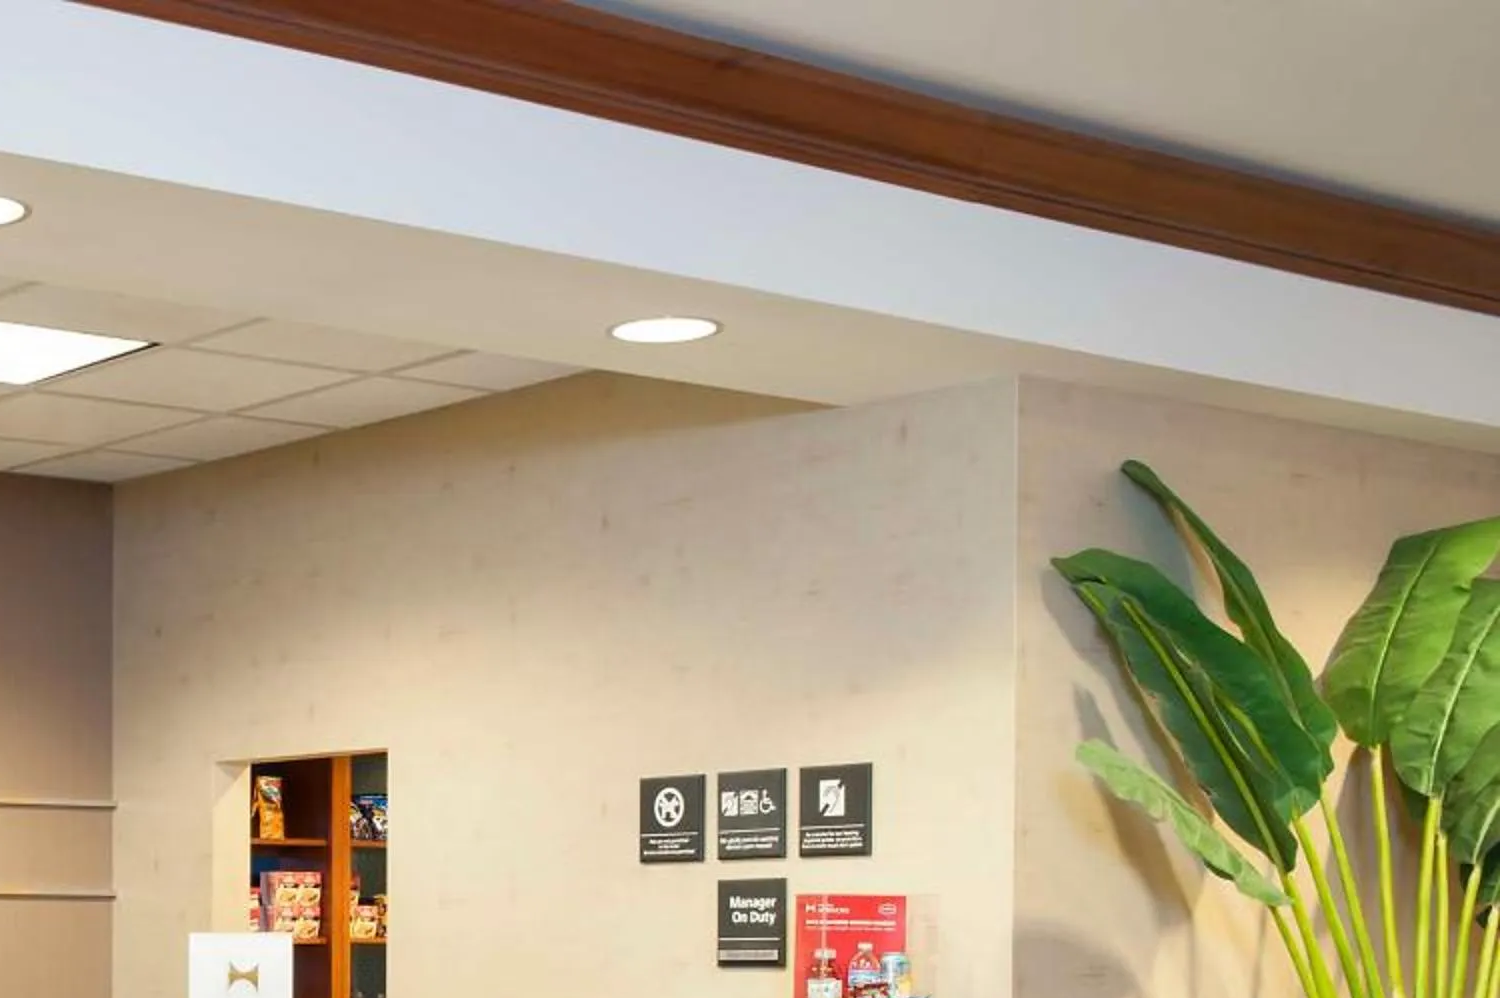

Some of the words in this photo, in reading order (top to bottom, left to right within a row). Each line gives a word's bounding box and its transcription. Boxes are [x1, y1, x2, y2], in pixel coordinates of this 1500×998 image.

[729, 896, 777, 911] Manager
[731, 911, 748, 923] On
[749, 910, 777, 926] Duty
